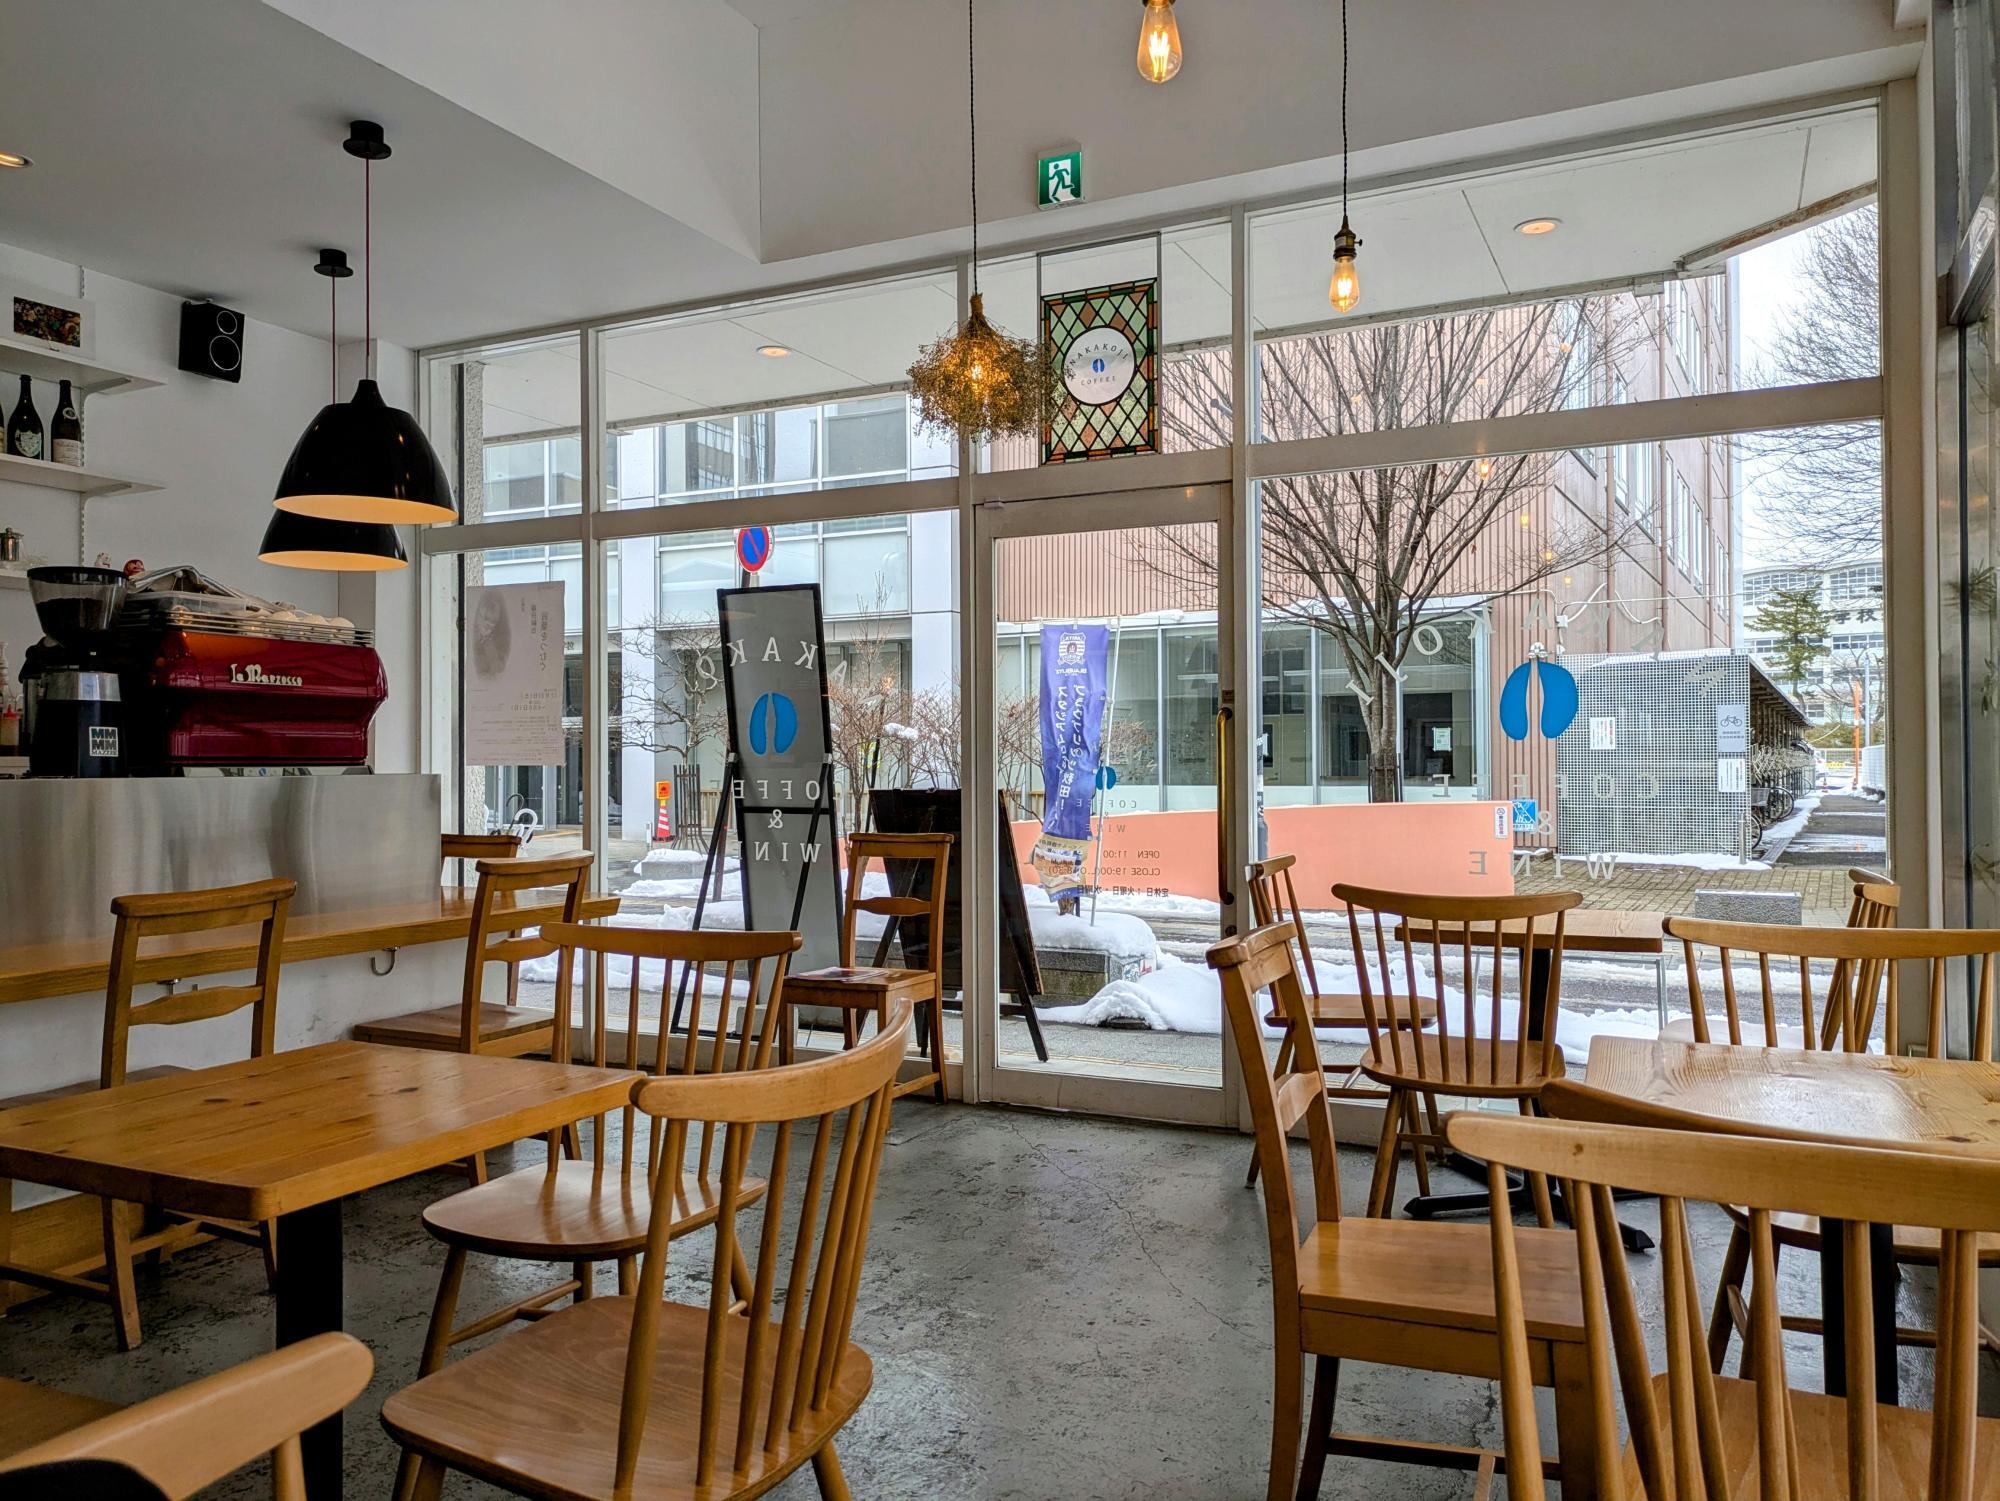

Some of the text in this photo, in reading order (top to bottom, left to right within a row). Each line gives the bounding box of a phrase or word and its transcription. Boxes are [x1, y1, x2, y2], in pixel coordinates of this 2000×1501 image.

[1069, 343, 1129, 365] NAKAKOJI
[1081, 375, 1116, 386] COFFEE
[245, 664, 303, 686] Marzocco
